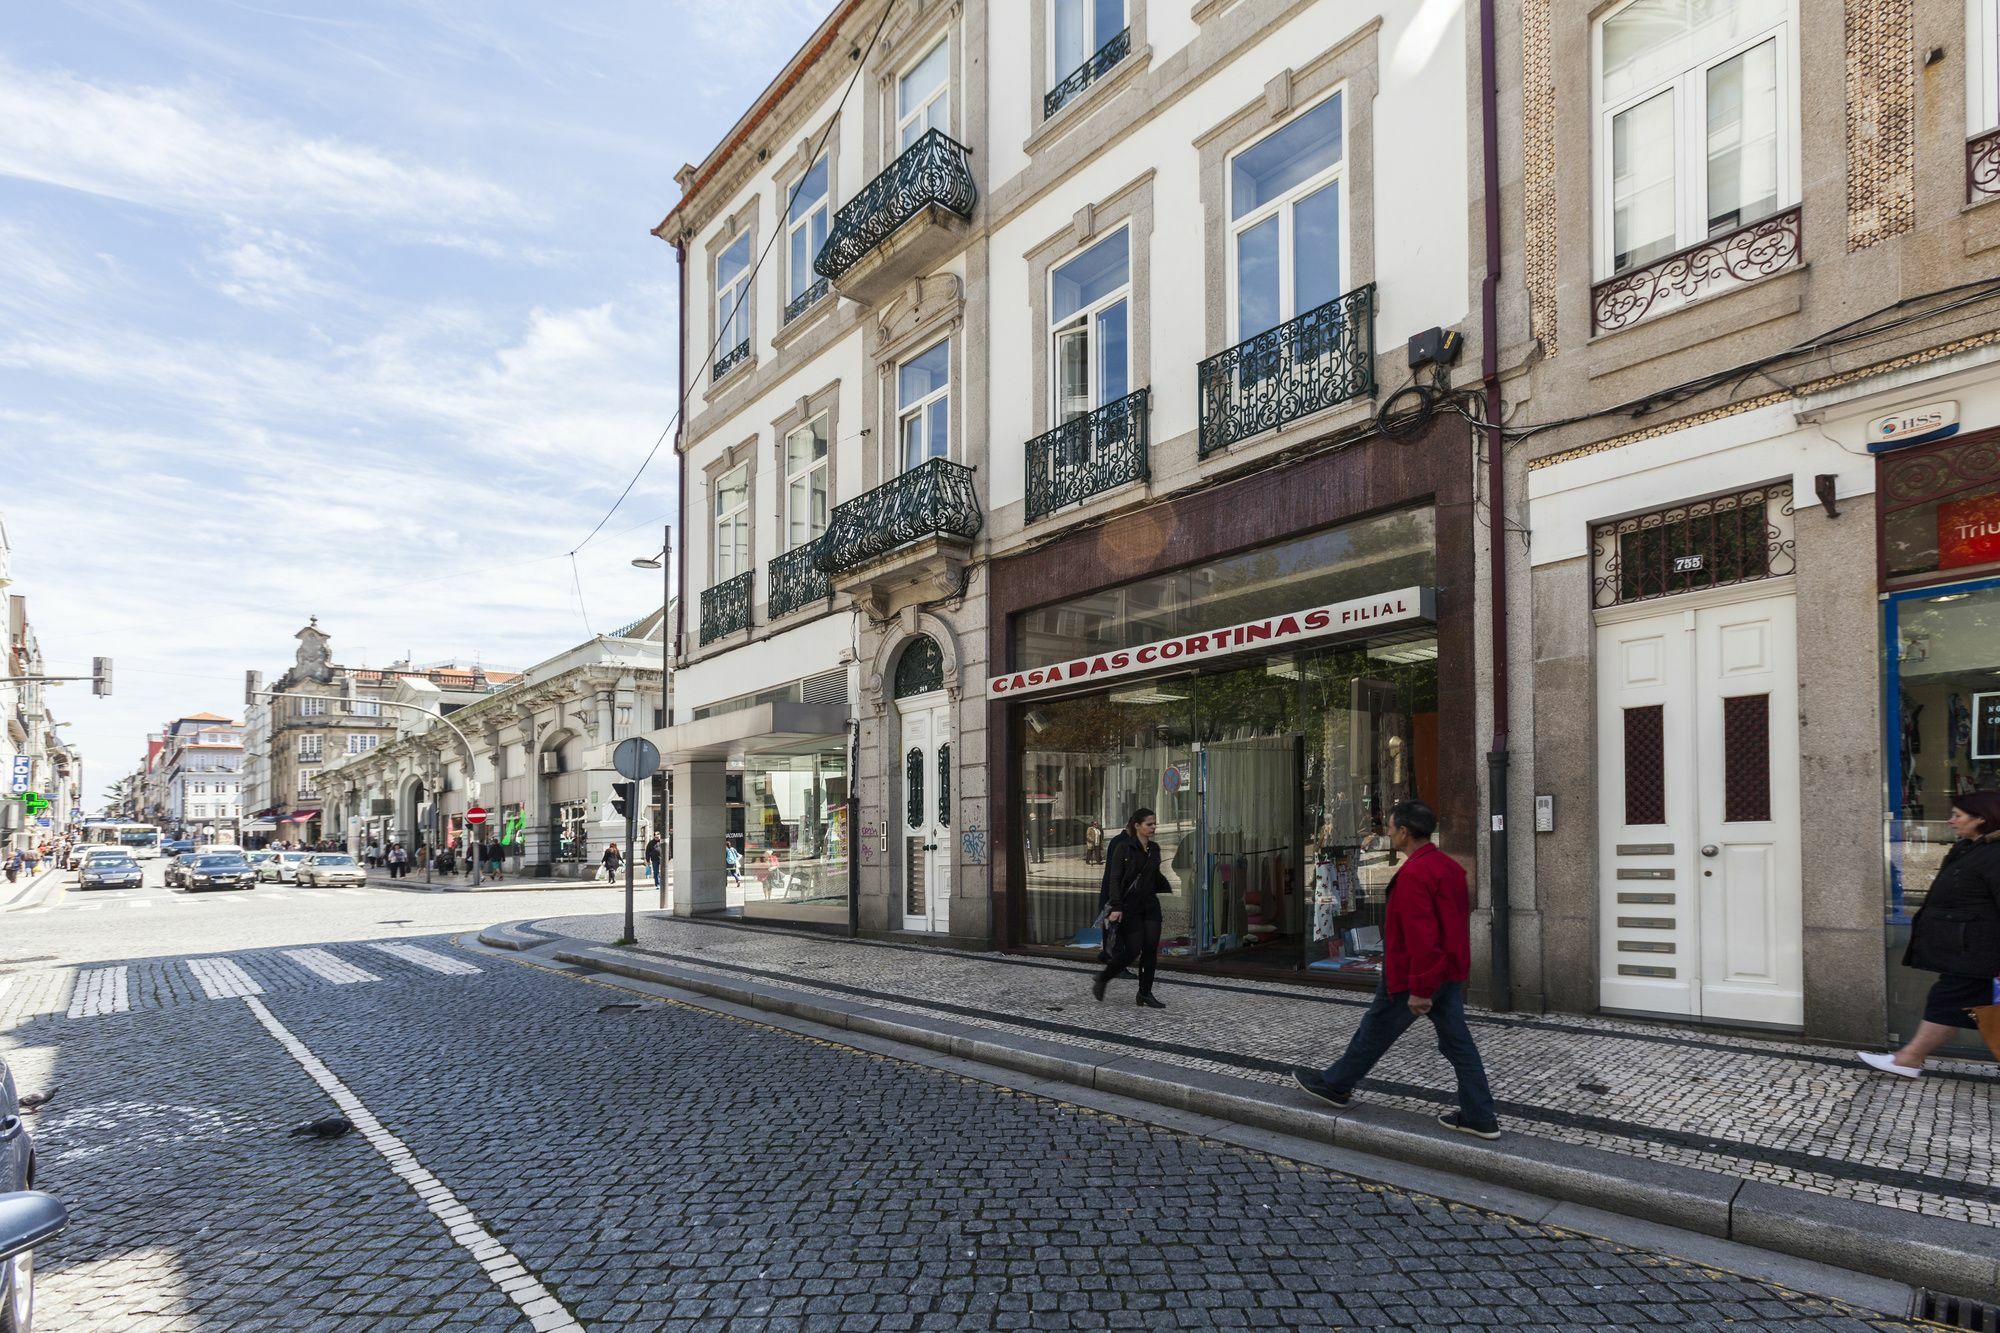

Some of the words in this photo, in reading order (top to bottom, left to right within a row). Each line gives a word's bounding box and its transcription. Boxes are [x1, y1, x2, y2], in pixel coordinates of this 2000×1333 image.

[1902, 411, 1942, 430] HSS
[1676, 556, 1701, 571] 755
[991, 666, 1064, 693] CASA
[1069, 652, 1130, 679] DAS
[1136, 609, 1330, 663] CORTINAS
[1342, 599, 1407, 624] FILIAL
[13, 756, 29, 792] FOTO
